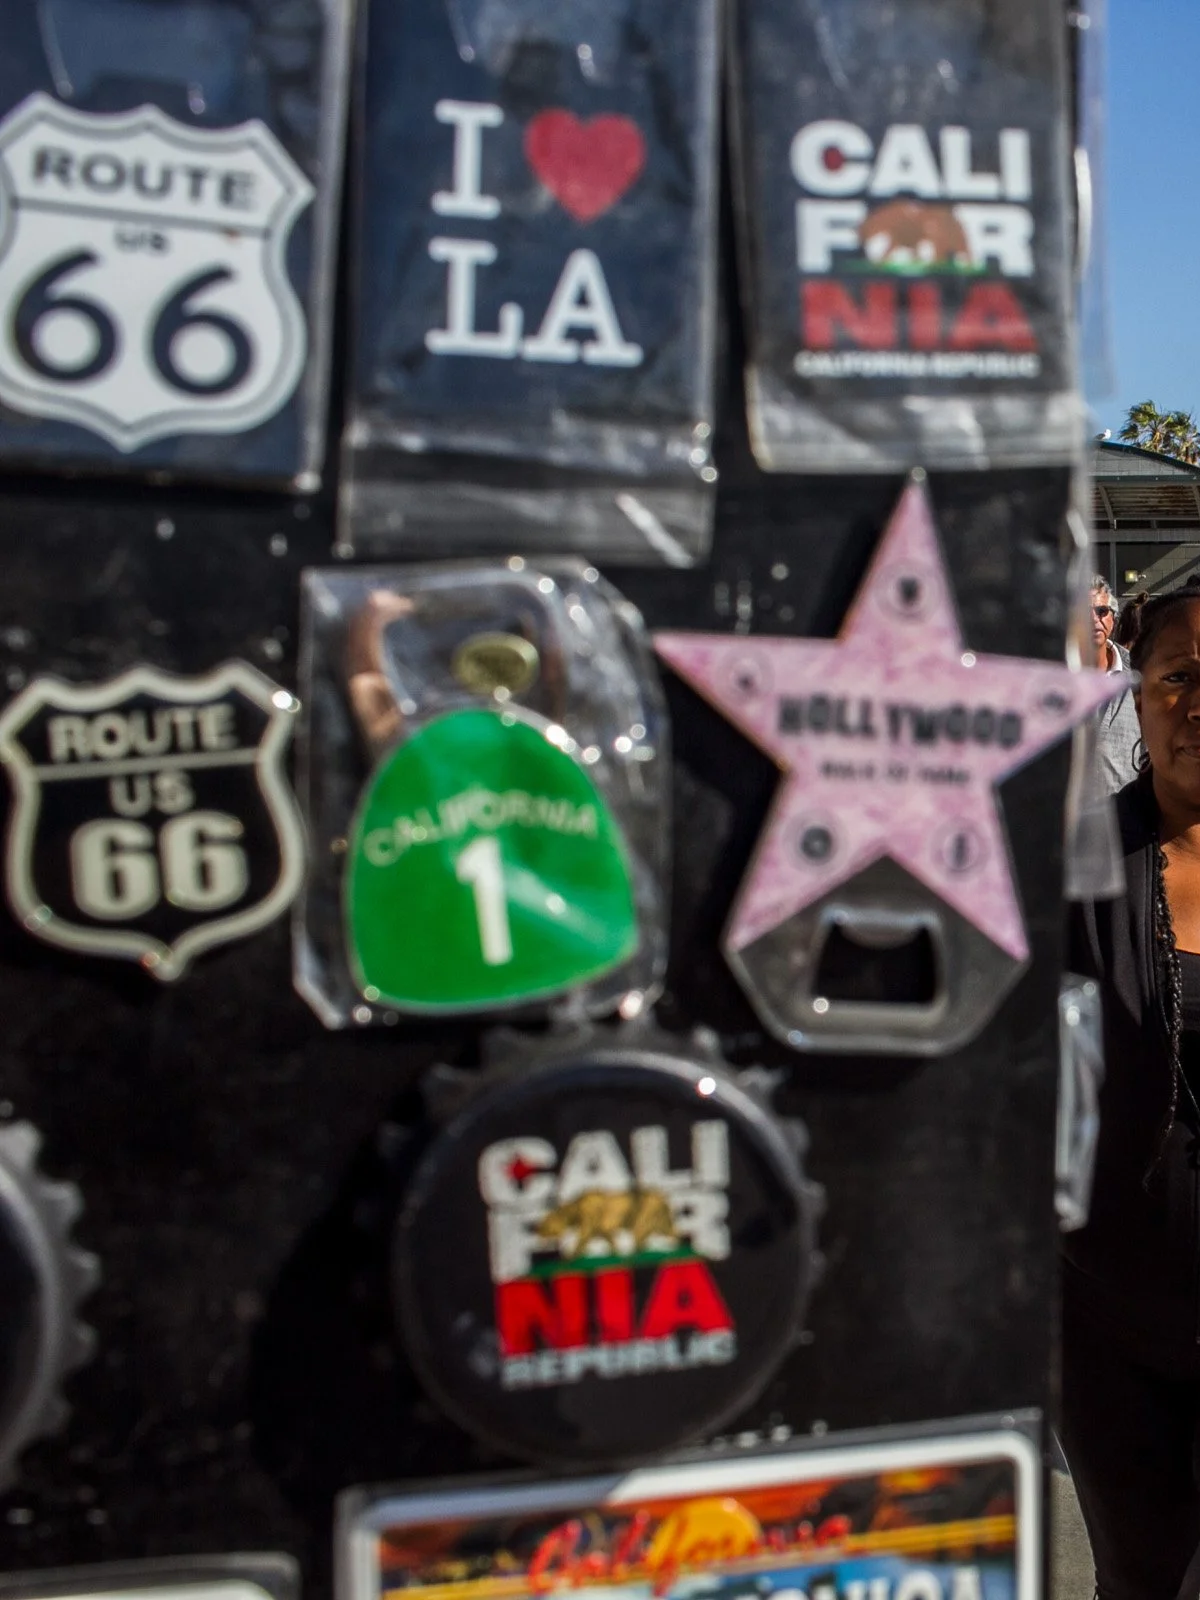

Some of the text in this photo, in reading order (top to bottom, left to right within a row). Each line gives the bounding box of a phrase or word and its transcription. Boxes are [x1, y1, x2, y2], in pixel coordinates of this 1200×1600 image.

[32, 145, 258, 212] ROUTE
[433, 99, 504, 220] I
[790, 119, 1031, 201] CALI
[797, 198, 1034, 276] FR
[13, 246, 256, 396] 66
[424, 235, 645, 368] LA
[803, 279, 1037, 352] NIA
[49, 703, 238, 764] ROUTE
[777, 693, 1025, 750] HOLLYWOOD
[110, 768, 195, 819] US
[362, 784, 598, 868] CALIFORNIA
[70, 808, 248, 921] 66
[454, 833, 514, 966] 1
[478, 1119, 730, 1205] CALI
[487, 1190, 731, 1285] FR
[497, 1260, 735, 1355] NIA
[502, 1330, 737, 1391] REPUBLIC
